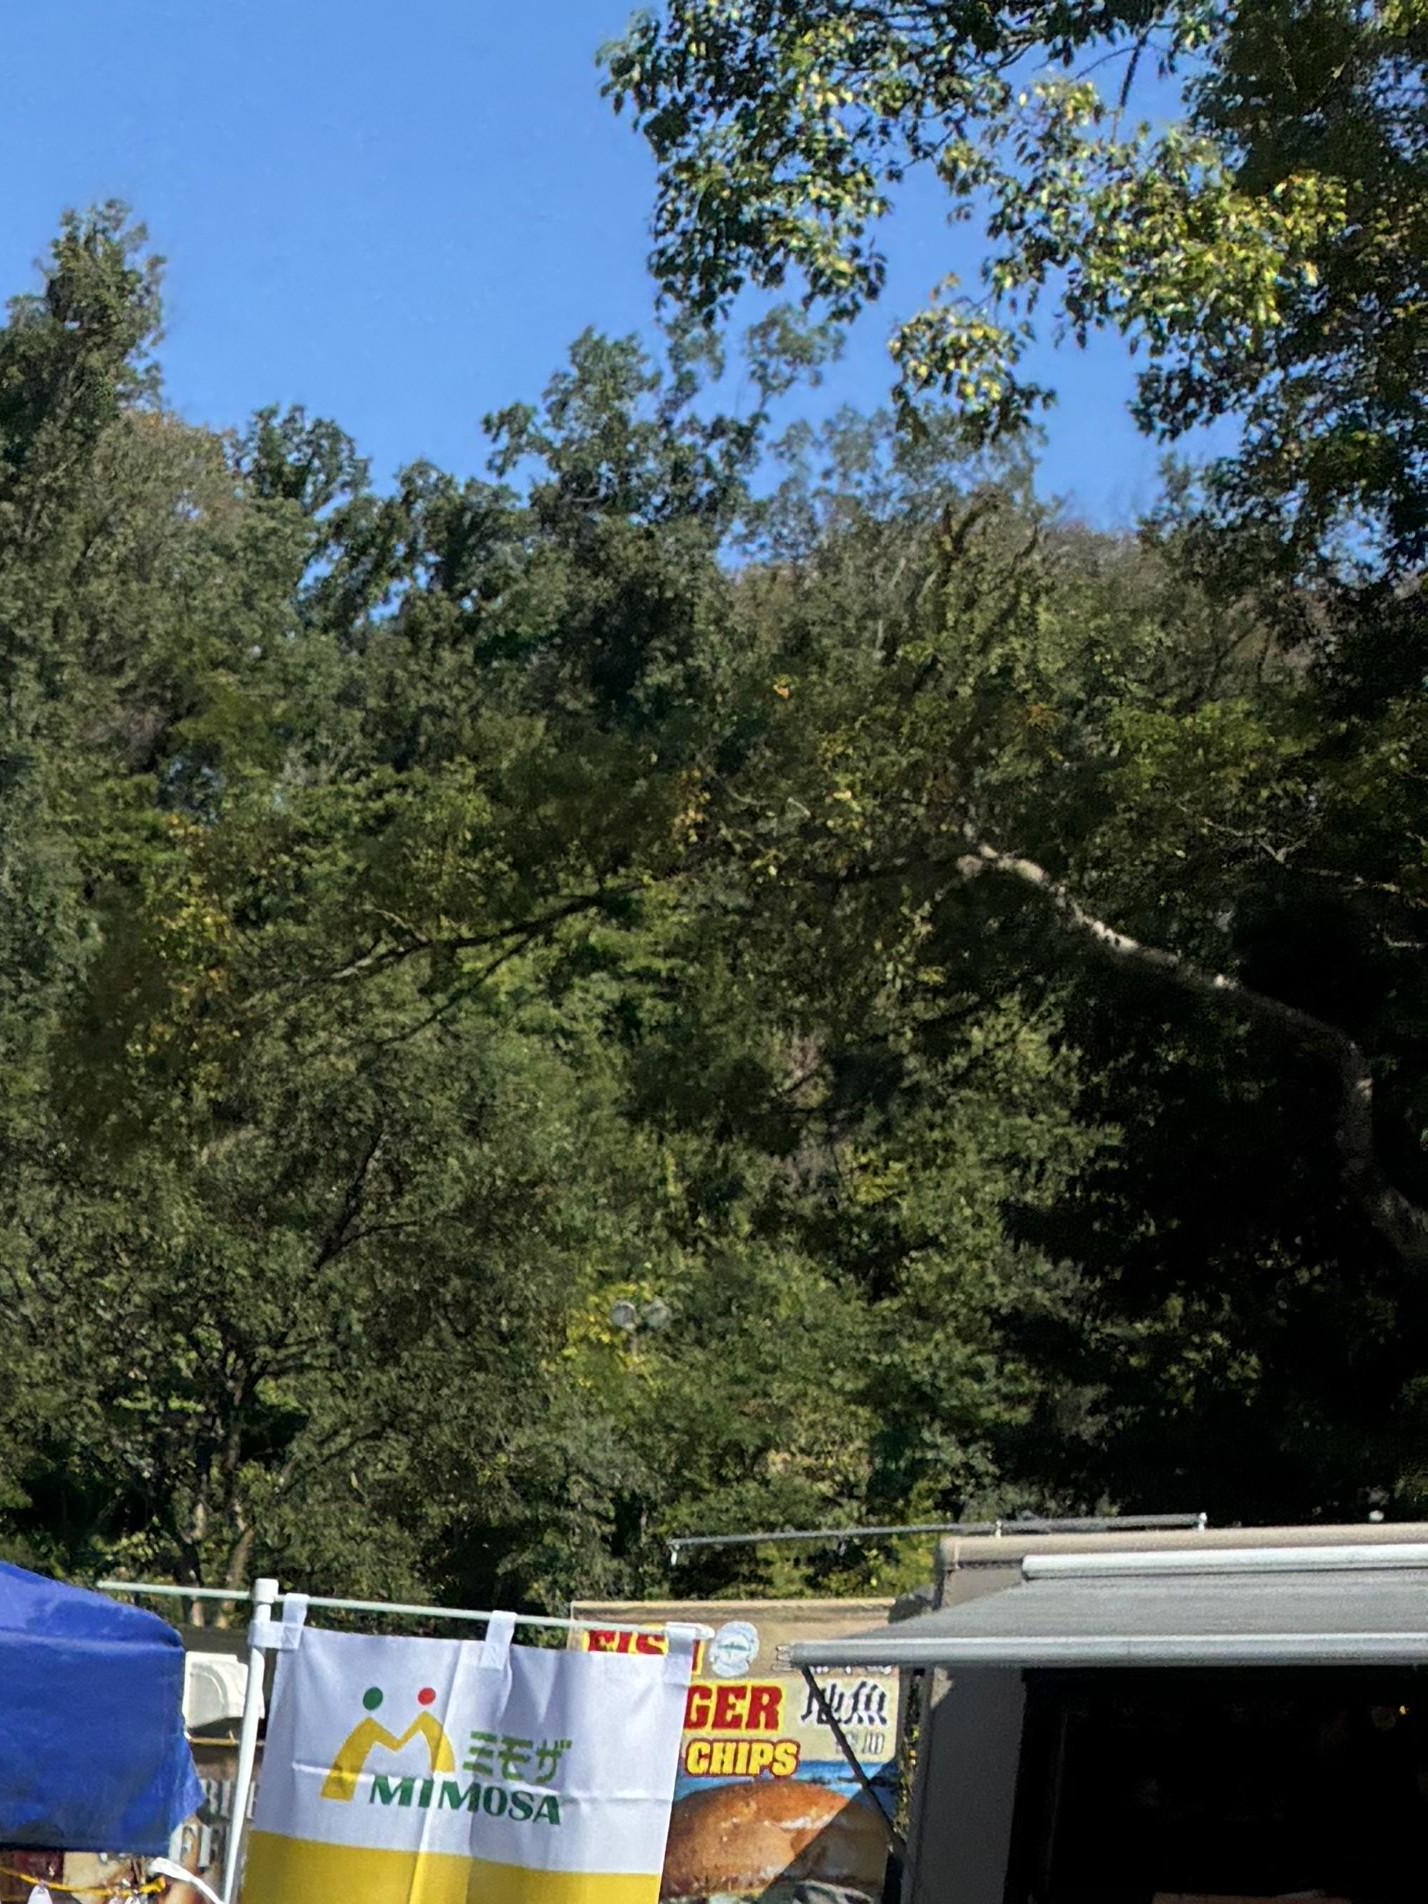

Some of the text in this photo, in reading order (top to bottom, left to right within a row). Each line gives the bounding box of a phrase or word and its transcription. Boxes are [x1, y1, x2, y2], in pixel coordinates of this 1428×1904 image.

[463, 1730, 573, 1784] ミモザ
[687, 1740, 800, 1776] CHIPS
[369, 1773, 564, 1827] MIMOSA
